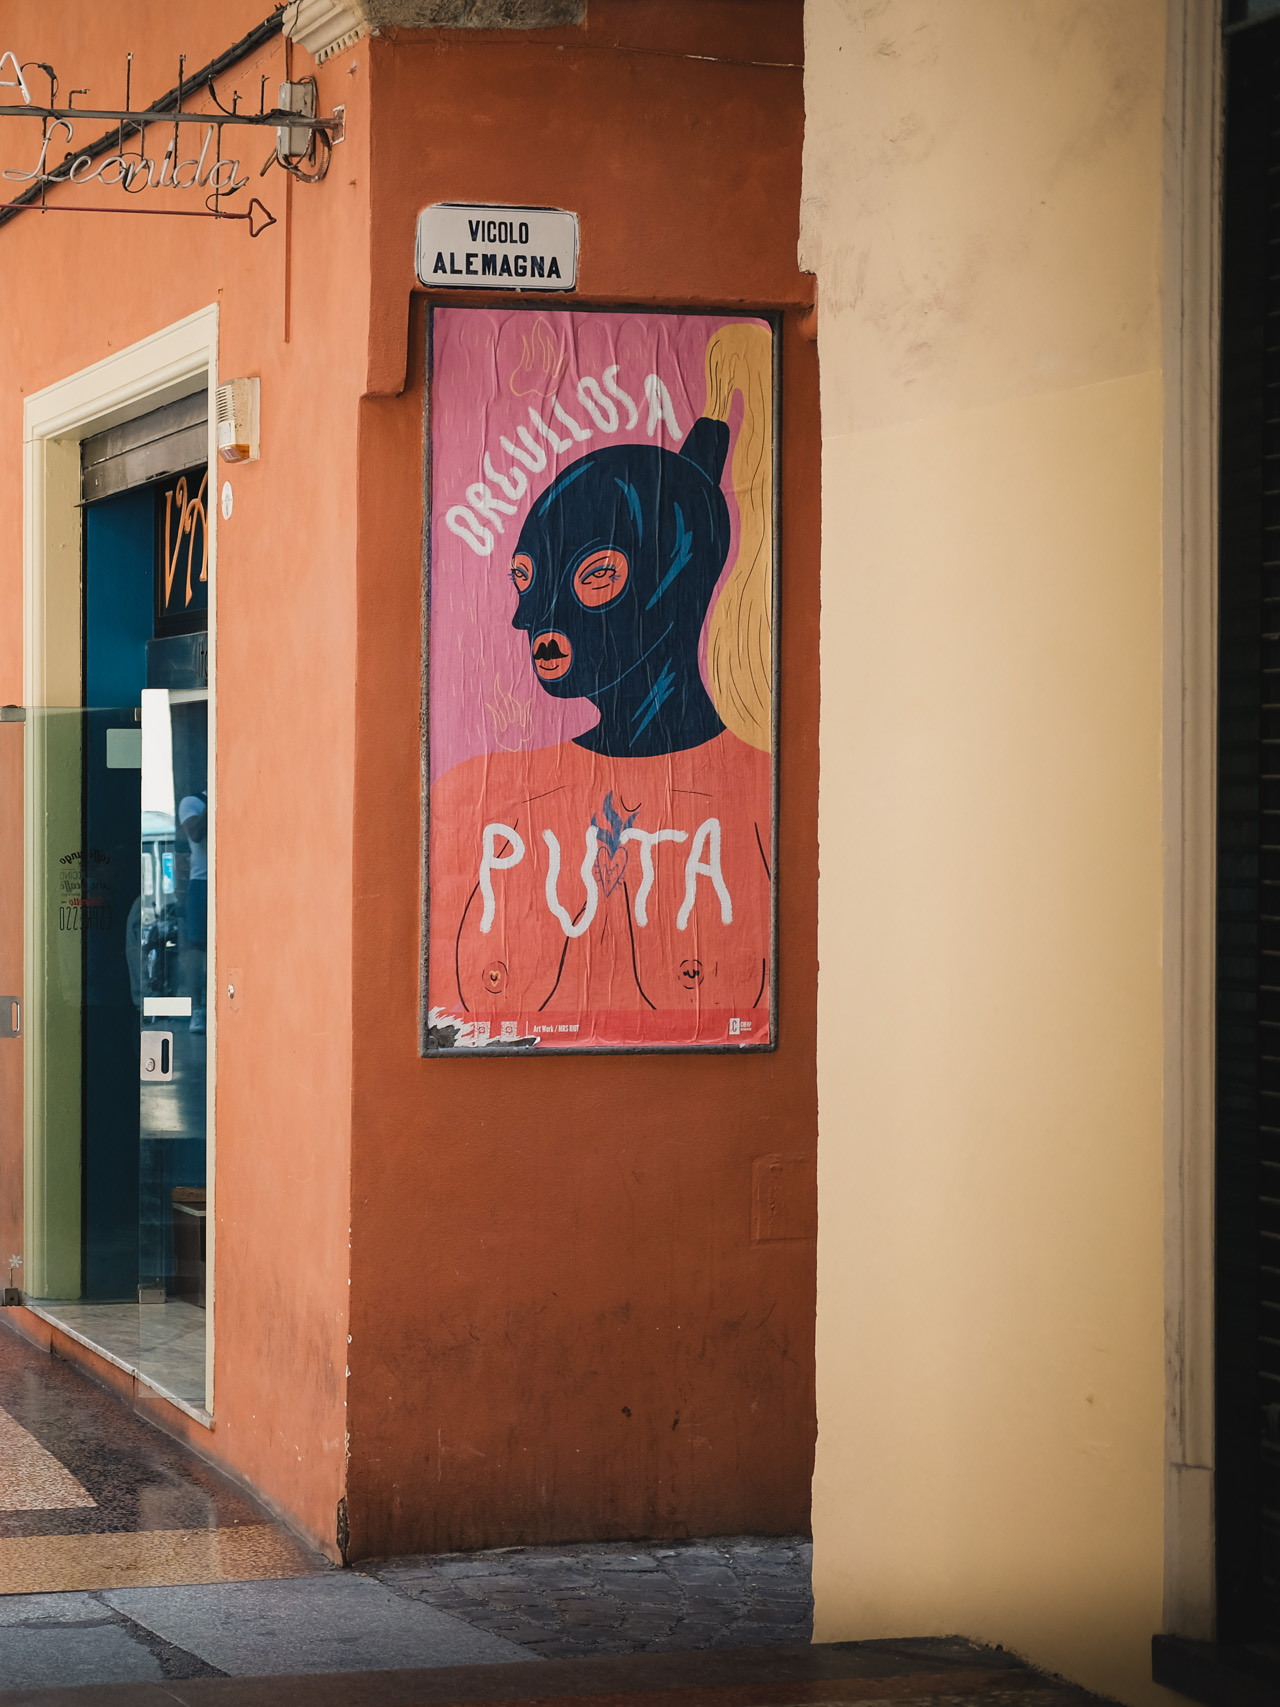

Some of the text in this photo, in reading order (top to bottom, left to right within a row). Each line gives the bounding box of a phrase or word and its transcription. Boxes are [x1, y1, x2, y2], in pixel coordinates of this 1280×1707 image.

[2, 119, 250, 189] Leonida
[432, 251, 562, 278] ALEMAGNA
[468, 219, 530, 244] VICOLO
[445, 364, 683, 557] ORGULLOSA
[479, 817, 733, 939] PUTA
